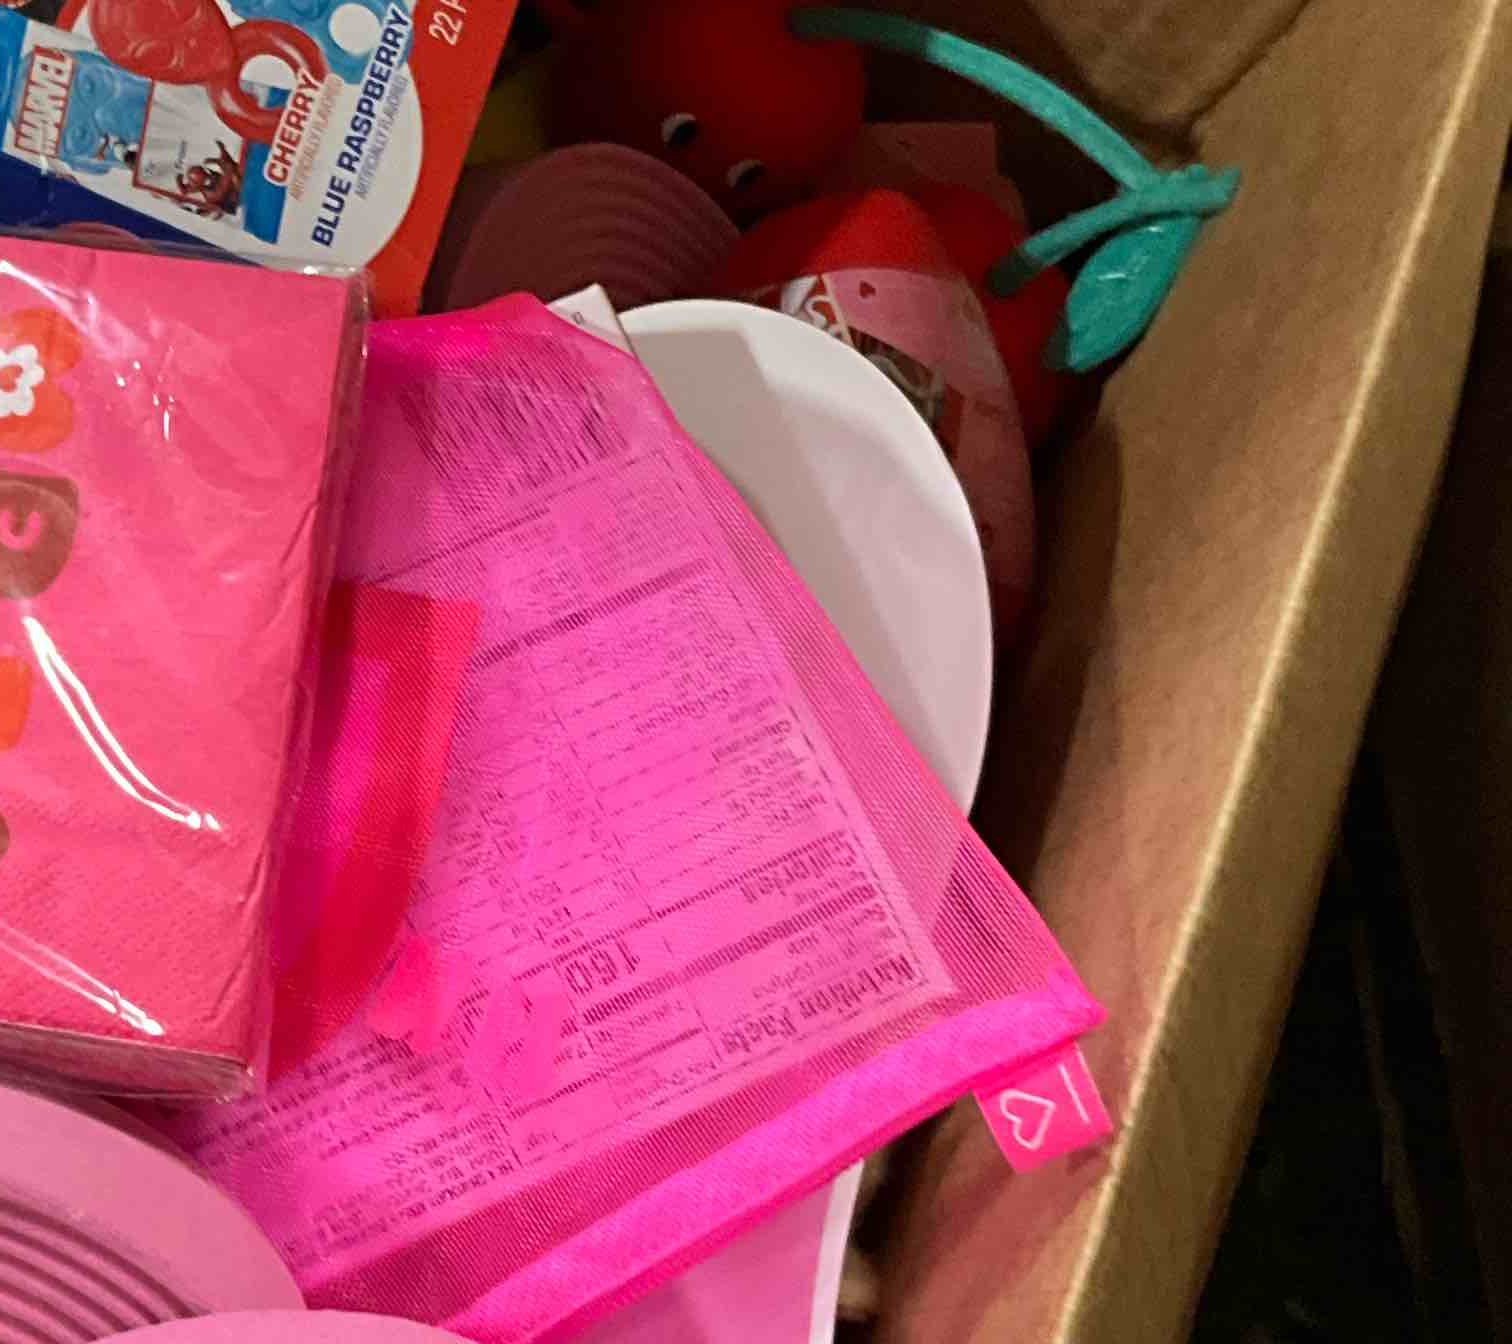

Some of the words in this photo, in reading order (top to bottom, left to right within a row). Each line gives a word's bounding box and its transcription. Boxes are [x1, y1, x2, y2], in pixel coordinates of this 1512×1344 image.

[429, 10, 464, 46] 22
[15, 52, 72, 157] MARVEL
[267, 72, 322, 184] CHERRY
[312, 175, 351, 246] BLUE
[339, 5, 410, 174] RASPBERRY
